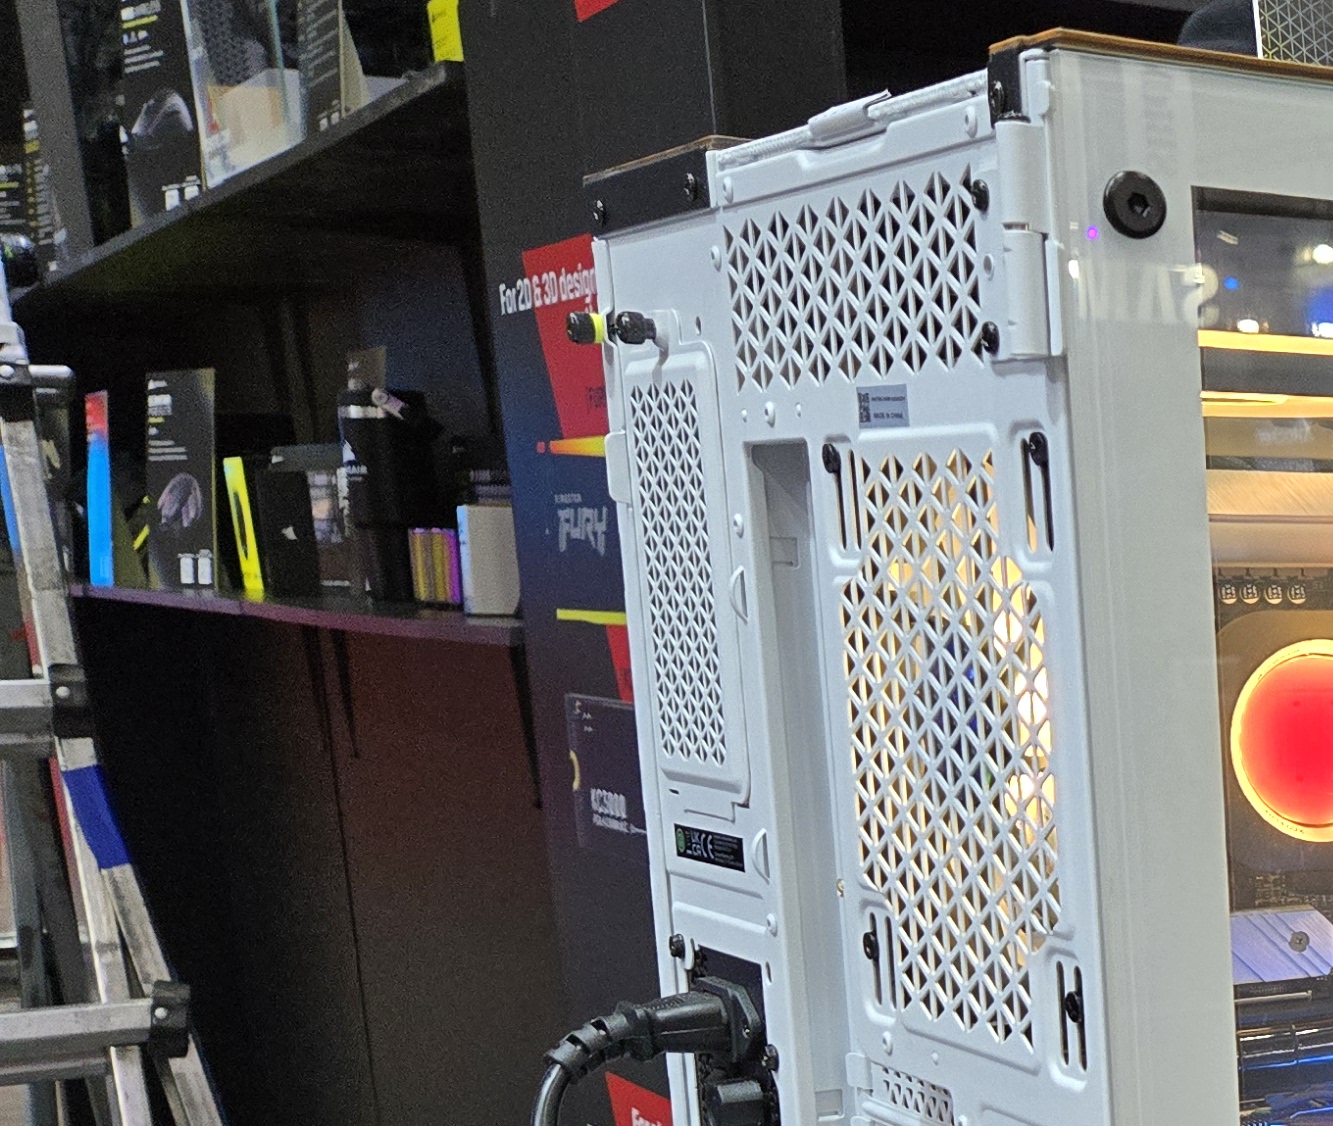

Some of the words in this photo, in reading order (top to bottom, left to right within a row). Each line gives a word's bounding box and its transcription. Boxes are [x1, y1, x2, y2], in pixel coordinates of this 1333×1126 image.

[499, 283, 518, 316] For
[517, 277, 532, 310] 2D
[532, 274, 543, 308] &
[542, 271, 559, 304] 3D
[557, 506, 609, 556] FURY
